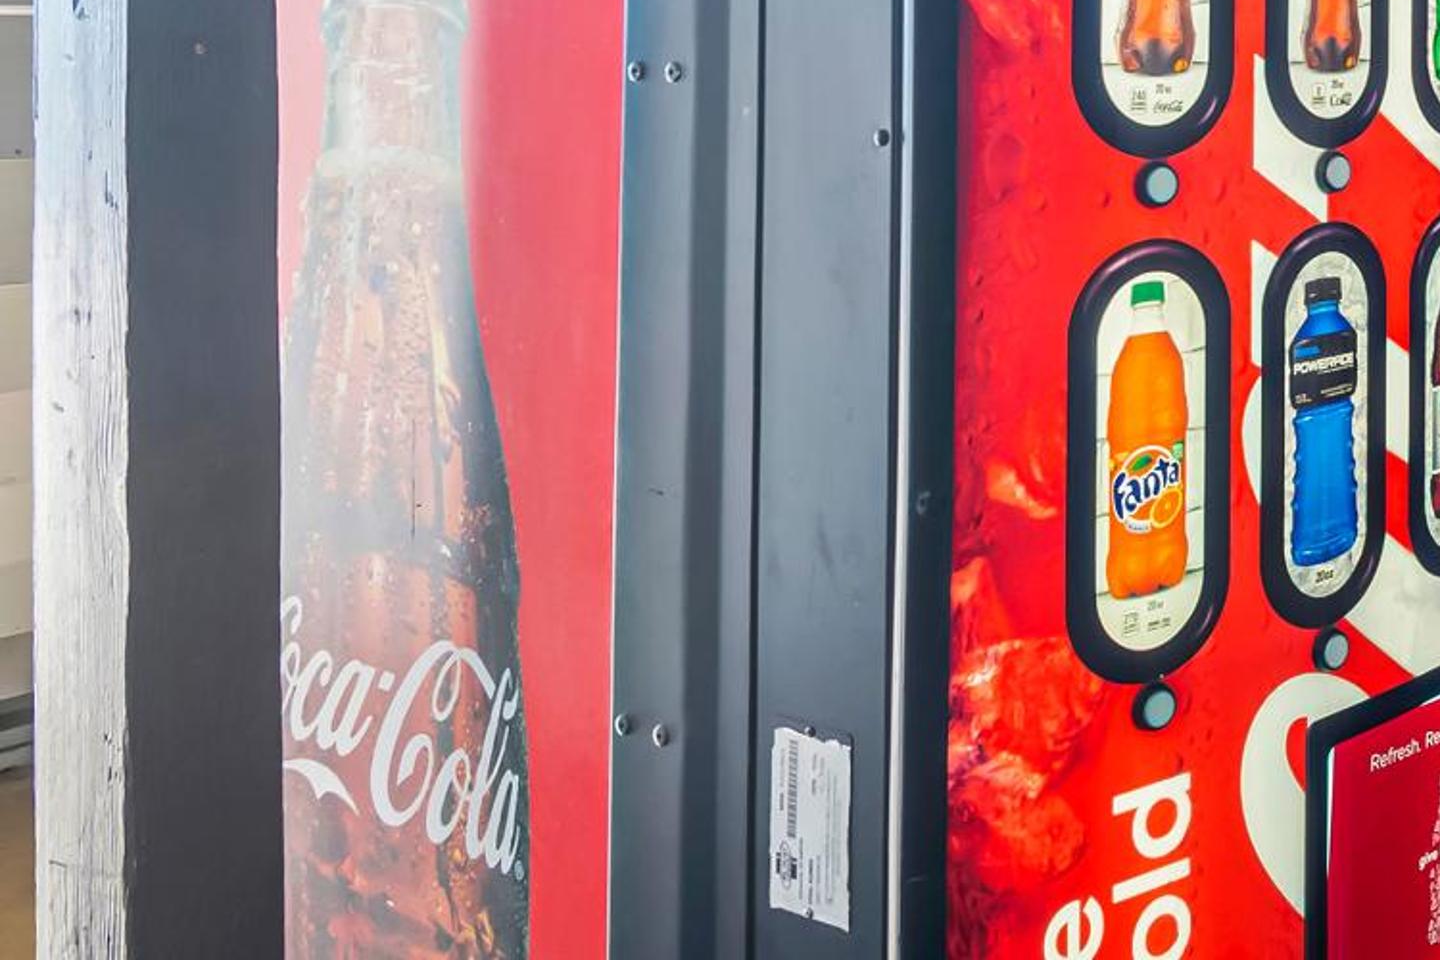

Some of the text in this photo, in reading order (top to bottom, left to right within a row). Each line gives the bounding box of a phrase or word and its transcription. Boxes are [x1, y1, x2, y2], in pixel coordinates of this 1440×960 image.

[1293, 351, 1355, 376] POWERADE
[1112, 457, 1181, 521] Fanta
[281, 595, 521, 874] oca-Cola
[1369, 738, 1421, 772] Refresh.
[1418, 850, 1438, 871] give
